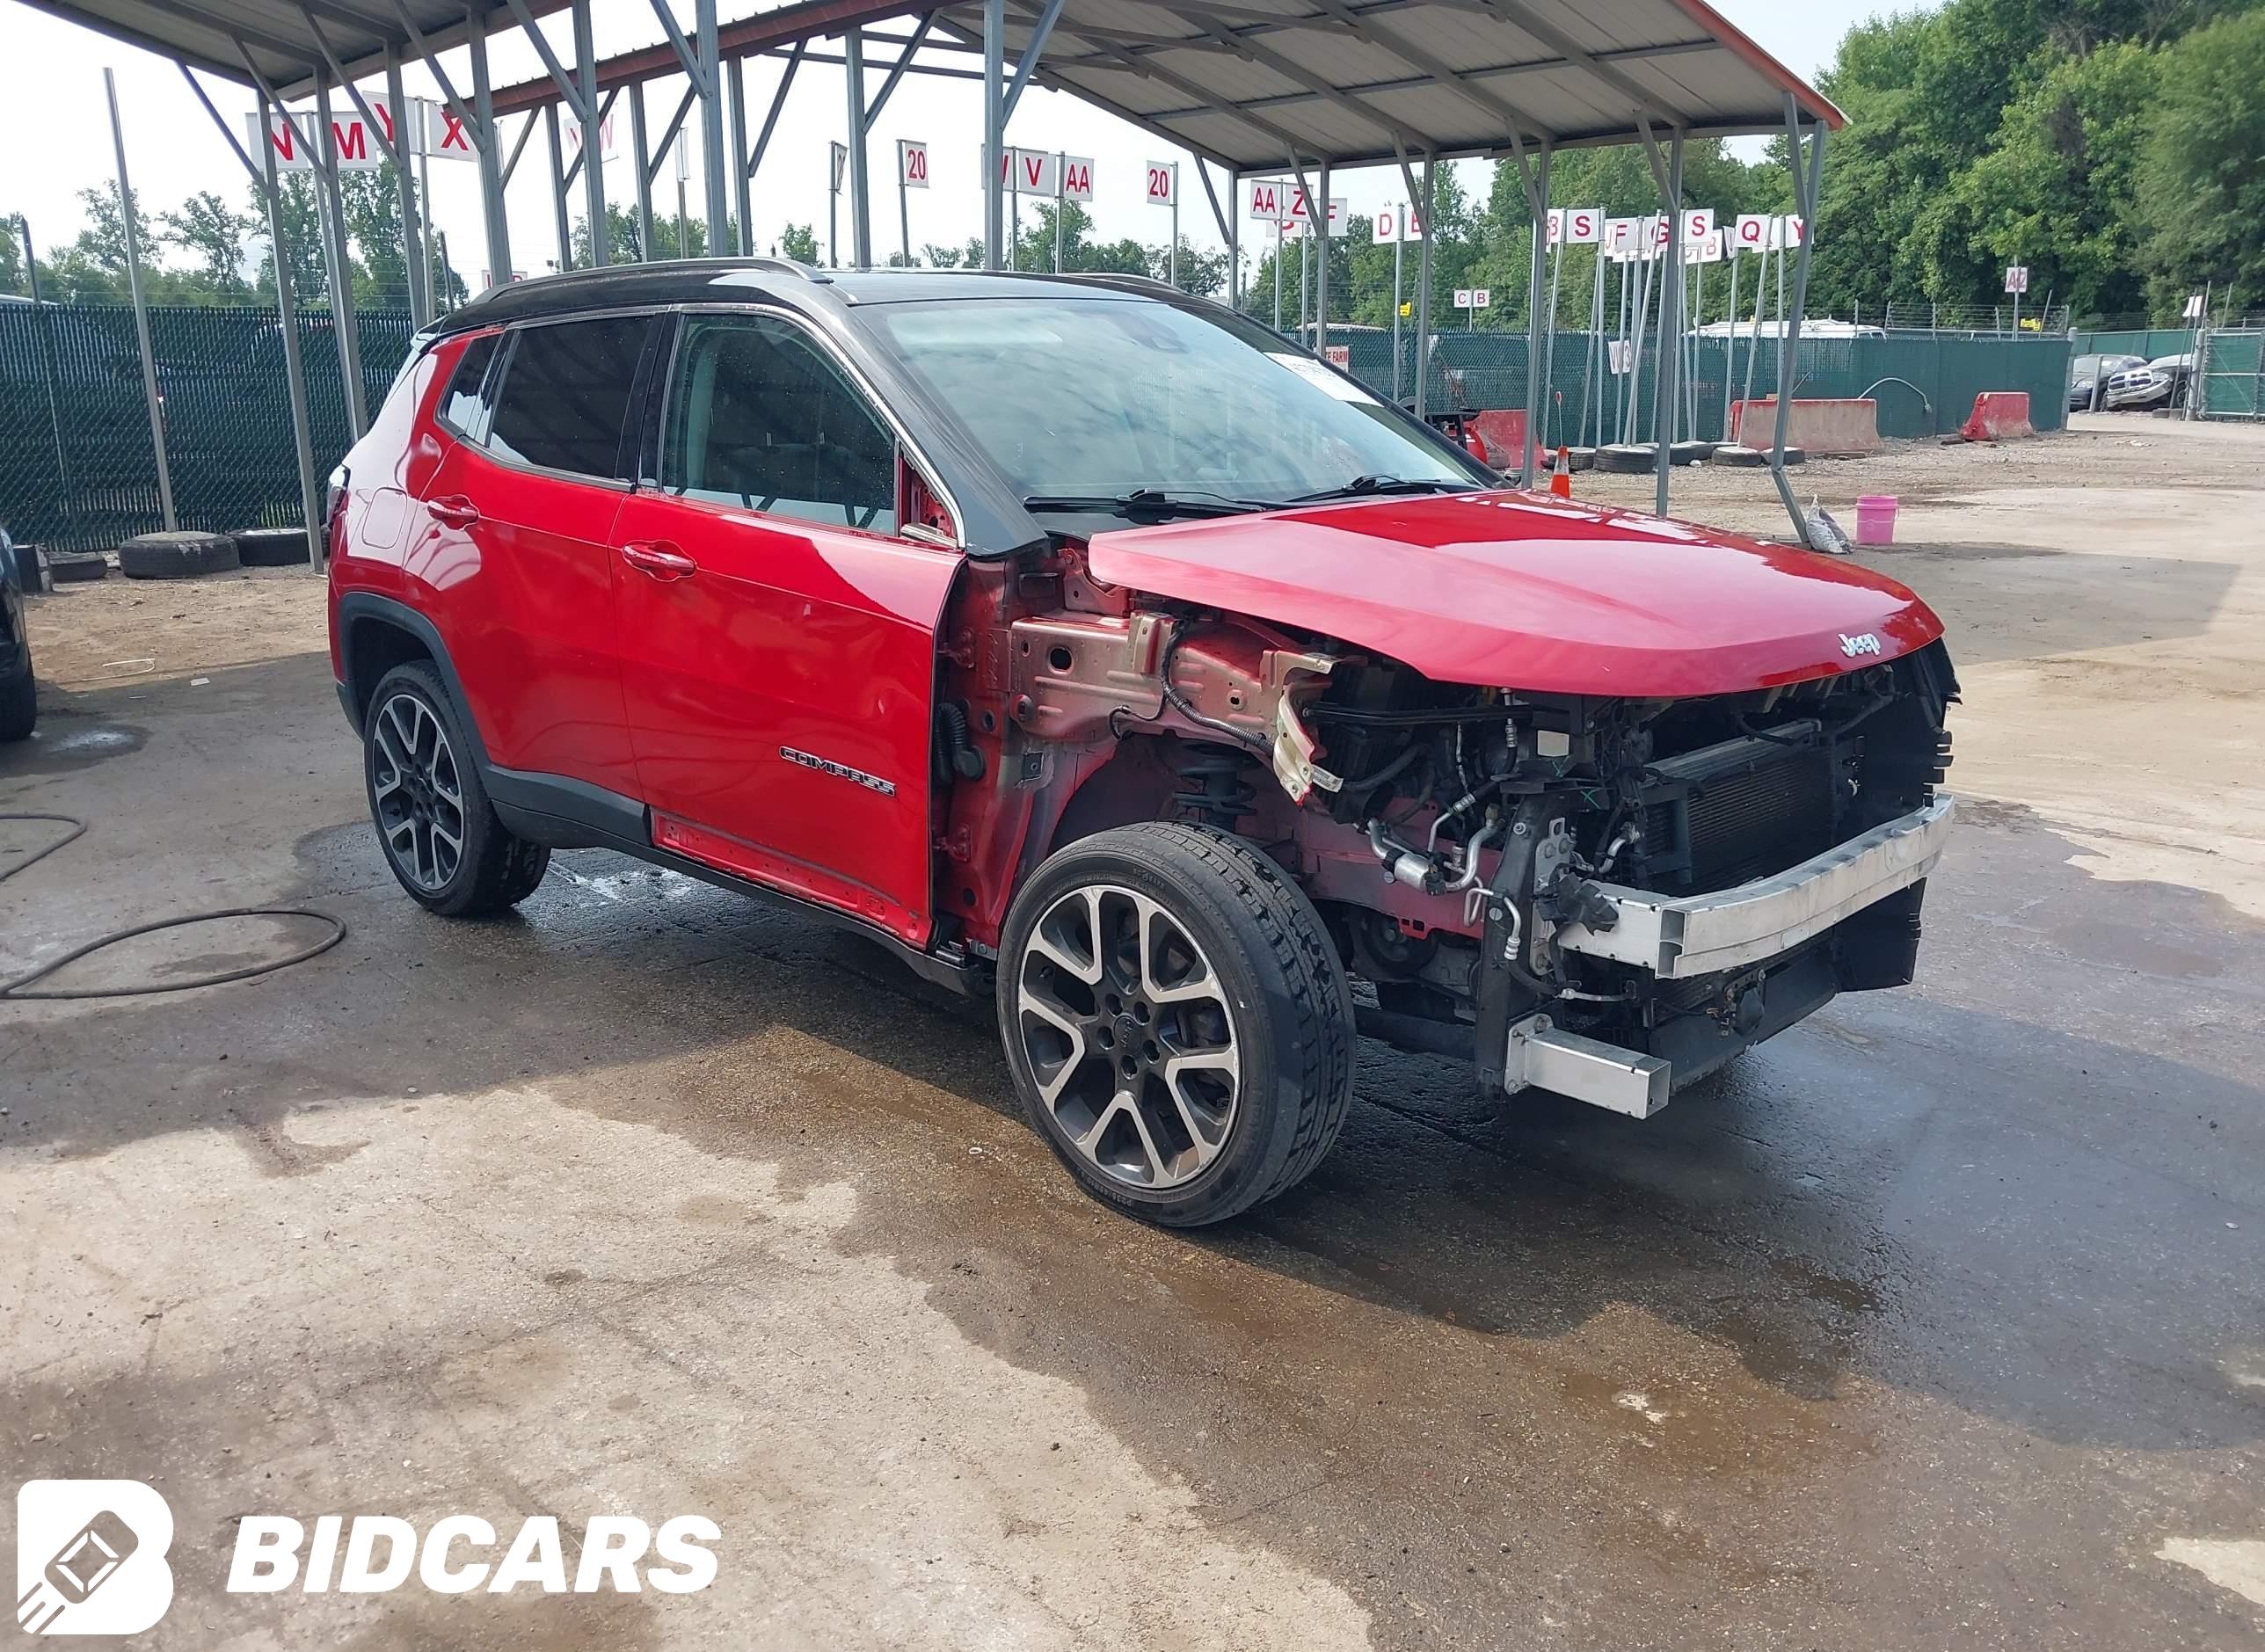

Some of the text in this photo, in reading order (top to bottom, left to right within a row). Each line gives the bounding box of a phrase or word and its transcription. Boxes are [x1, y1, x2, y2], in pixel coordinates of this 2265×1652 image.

[333, 121, 367, 161] M
[441, 112, 470, 151] X
[907, 149, 927, 180] 20
[1024, 156, 1043, 187] V
[1065, 164, 1090, 194] AA
[1149, 168, 1169, 198] 20
[1252, 186, 1307, 216] AA Z
[1379, 214, 1393, 237] D
[1574, 215, 1591, 237] S
[1615, 222, 1671, 246] F G
[1691, 215, 1706, 237] S
[1741, 220, 1759, 243] Q
[1457, 292, 1487, 304] C B
[1332, 350, 1348, 363] FARM
[1838, 632, 1881, 658] Jeep
[779, 746, 897, 797] COMPASS
